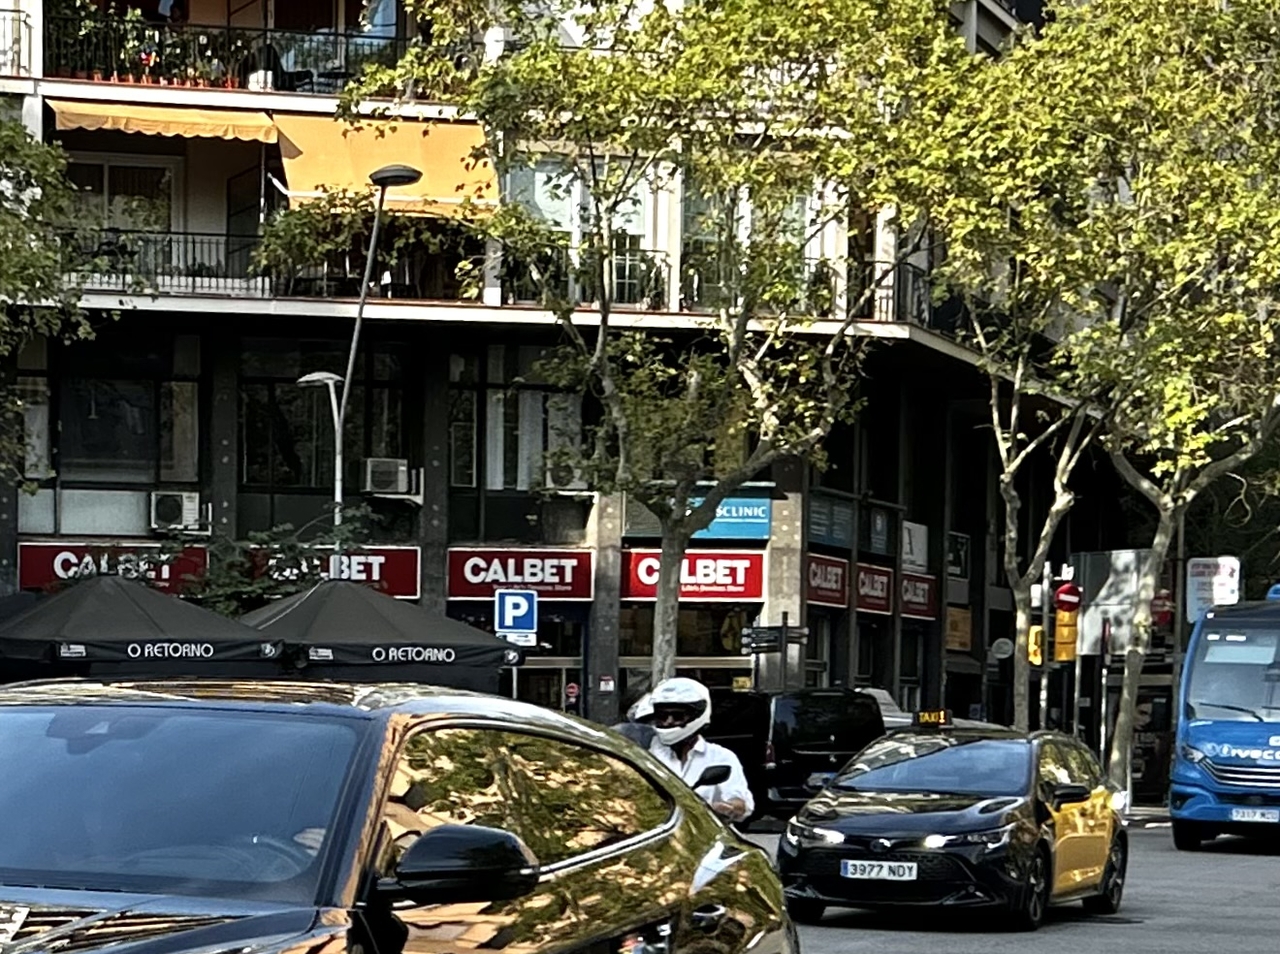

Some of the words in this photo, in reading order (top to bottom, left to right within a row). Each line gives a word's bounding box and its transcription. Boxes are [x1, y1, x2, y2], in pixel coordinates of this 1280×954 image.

[464, 556, 578, 583] CALBET
[637, 557, 751, 585] CLBET
[503, 595, 529, 627] P
[127, 643, 141, 658] O
[144, 642, 214, 658] RETORNO
[372, 647, 386, 662] O
[388, 647, 456, 662] RETORNO
[849, 863, 883, 877] 3977
[888, 865, 915, 878] NDY
